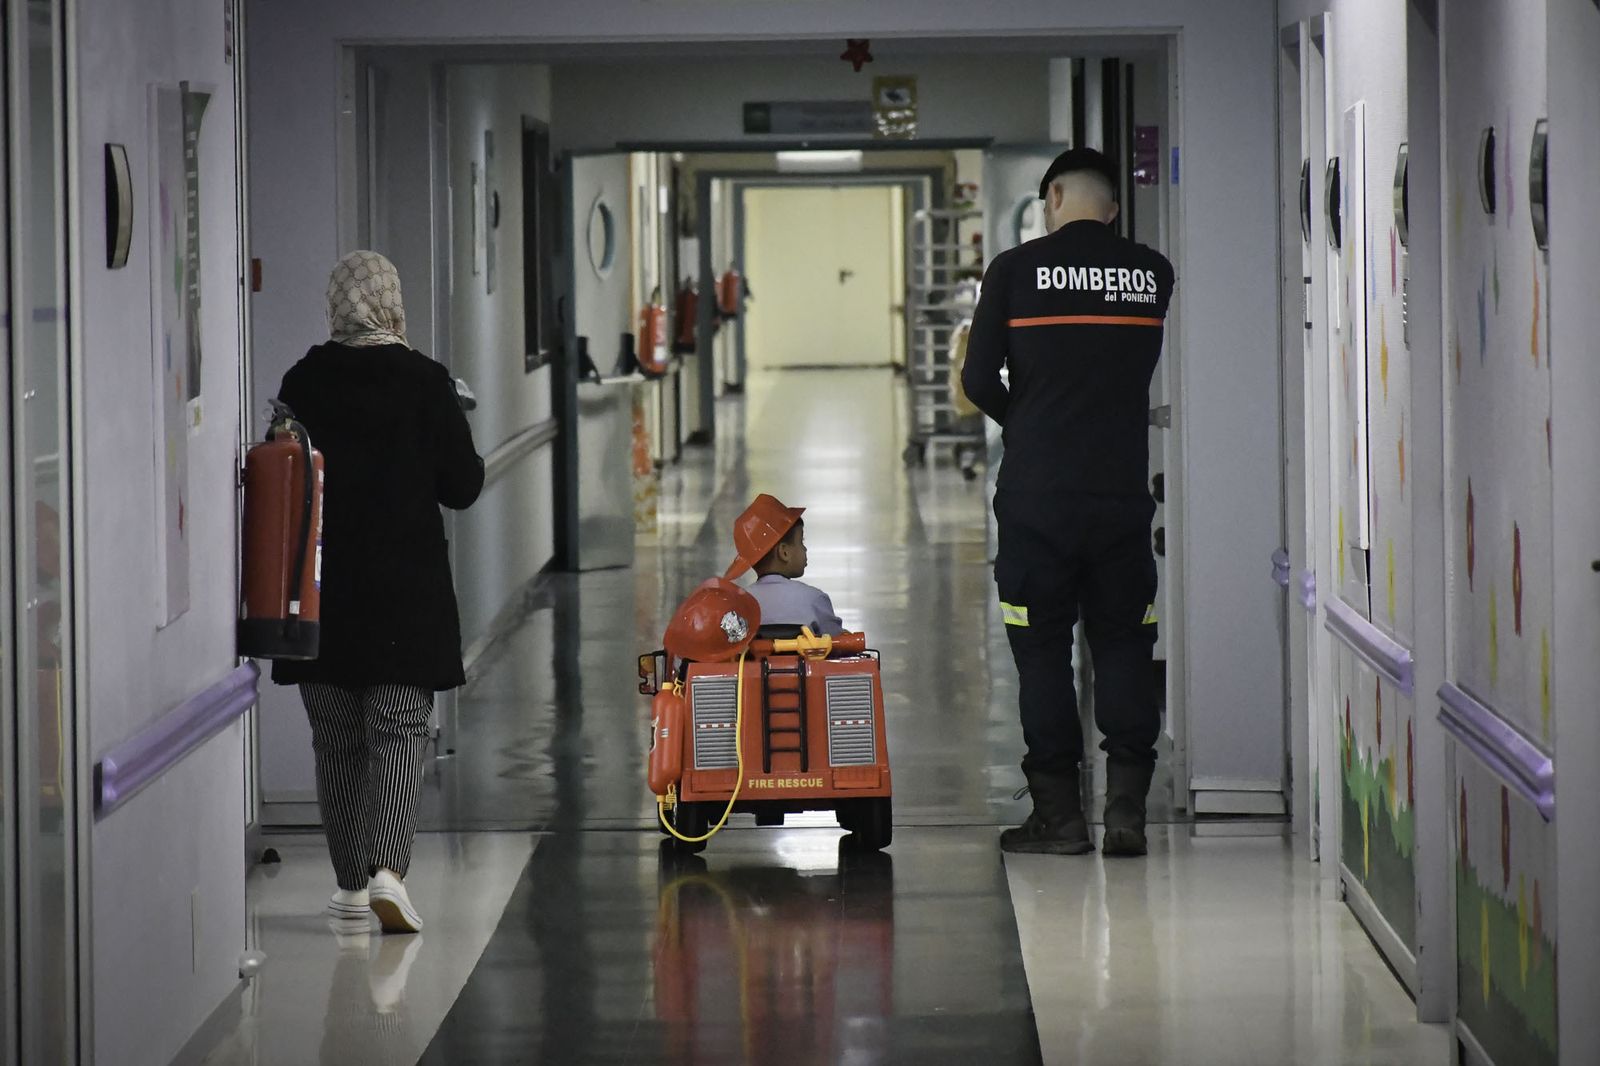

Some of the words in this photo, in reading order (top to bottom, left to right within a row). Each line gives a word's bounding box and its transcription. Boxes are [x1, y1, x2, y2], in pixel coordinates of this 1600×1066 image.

[1036, 266, 1157, 294] BOMBEROS
[1104, 291, 1117, 302] del
[1121, 291, 1157, 304] PONIENTE
[748, 778, 775, 789] FIRE
[777, 777, 824, 788] RESCUE
